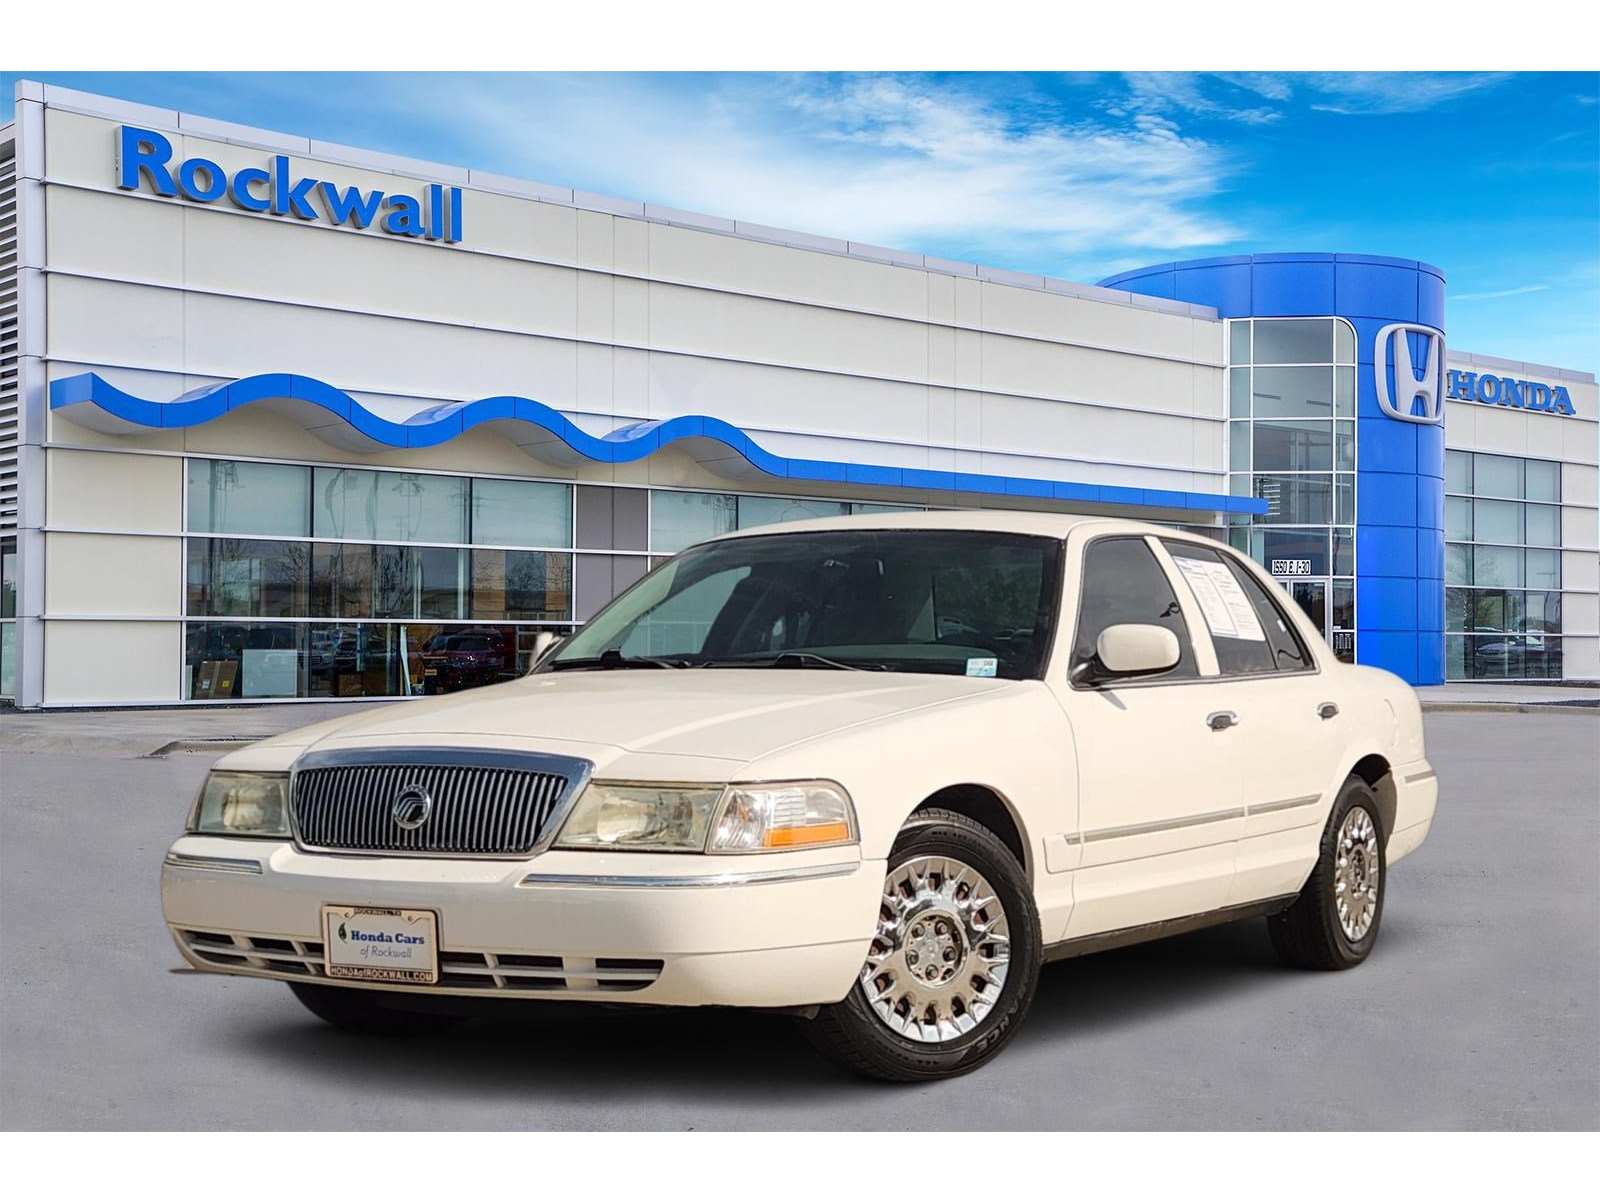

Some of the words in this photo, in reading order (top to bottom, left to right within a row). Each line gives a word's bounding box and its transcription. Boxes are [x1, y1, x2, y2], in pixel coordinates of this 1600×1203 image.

[116, 125, 463, 244] Rockwall
[1446, 369, 1577, 415] HONDA
[352, 930, 393, 942] Honda
[395, 933, 425, 945] Cars
[360, 945, 370, 960] of
[371, 945, 412, 959] Rockwall
